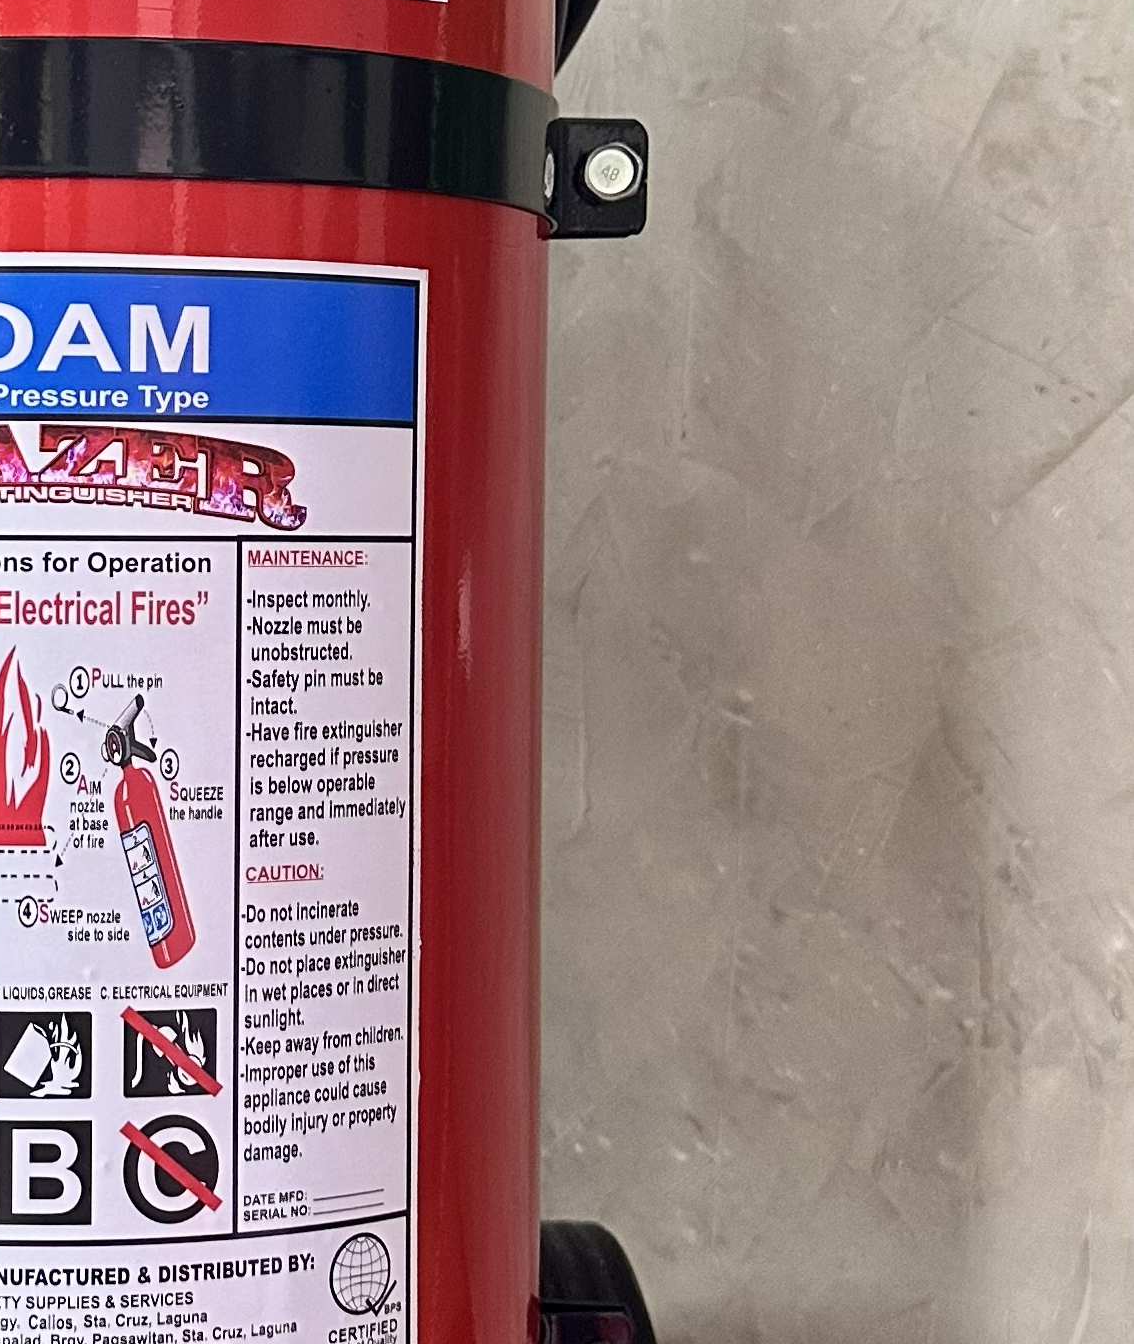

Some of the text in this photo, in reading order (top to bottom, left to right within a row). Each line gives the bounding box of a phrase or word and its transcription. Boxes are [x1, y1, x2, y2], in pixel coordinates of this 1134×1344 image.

[137, 384, 210, 412] Type
[43, 552, 79, 572] for
[88, 552, 211, 577] Operation
[248, 550, 368, 567] MAINTENANCE:
[313, 589, 370, 612] monthly.
[307, 616, 342, 634] must
[347, 616, 362, 634] be
[252, 642, 352, 661] unobstructed.
[92, 668, 124, 688] PULL
[127, 674, 144, 688] the
[147, 674, 163, 690] pin
[304, 670, 326, 692] pin
[331, 669, 364, 687] must
[369, 668, 383, 685] be
[251, 696, 297, 715] intact.
[170, 782, 223, 801] SQUEEZE
[170, 805, 222, 820] the handle
[246, 864, 324, 883] CAUTION:
[271, 904, 292, 922] not
[297, 900, 359, 920] incinerate
[245, 924, 403, 949] contents under pressure.
[3, 987, 91, 1002] LIQUIDS,GREASE
[286, 1036, 319, 1055] away
[323, 1031, 351, 1049] from
[356, 1025, 403, 1045] children.
[12, 1128, 82, 1214] B
[244, 1193, 275, 1206] DATE
[244, 1205, 310, 1222] SERIAL NO:
[138, 1267, 151, 1284] &
[159, 1257, 282, 1283] DISTRIBUTED
[289, 1253, 314, 1272] BY:
[26, 1296, 100, 1309] SUPPLIES
[105, 1295, 115, 1308] &
[121, 1292, 193, 1308] SERVICES
[84, 1315, 110, 1328] Sta.
[116, 1314, 151, 1328] Cruz,
[157, 1312, 207, 1327] Laguna
[182, 1329, 207, 1342] Sta.
[213, 1327, 246, 1340] Cruz,
[251, 1322, 297, 1338] Laguna
[329, 1319, 398, 1344] CERTIFIED
